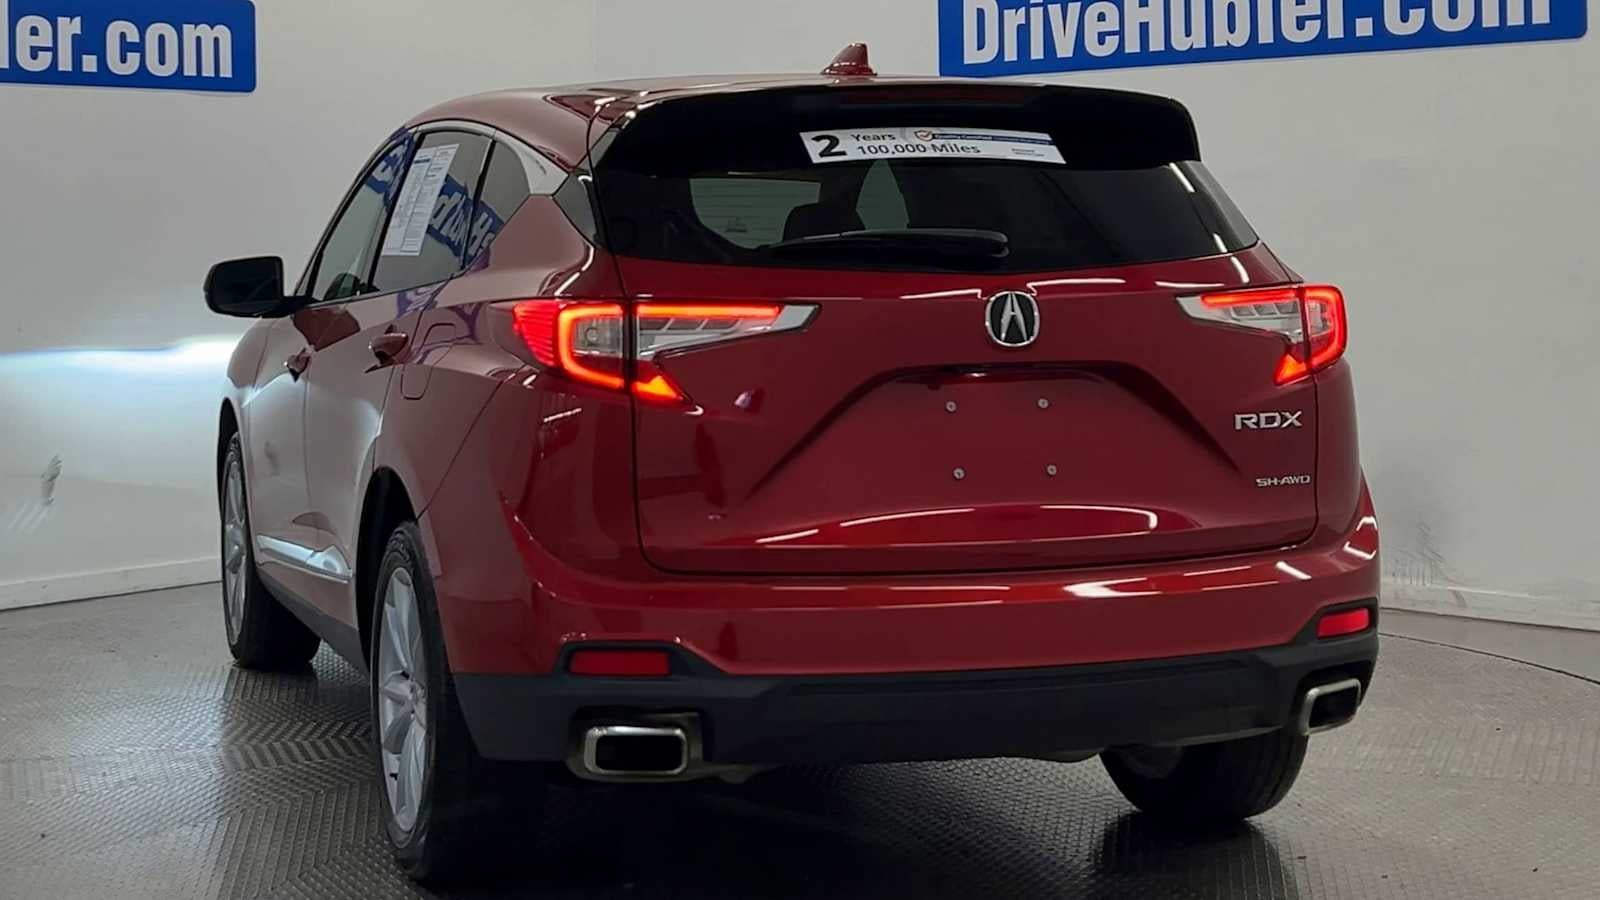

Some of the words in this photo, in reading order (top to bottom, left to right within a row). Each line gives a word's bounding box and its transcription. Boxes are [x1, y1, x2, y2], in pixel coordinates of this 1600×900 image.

[851, 132, 896, 142] Years
[811, 134, 847, 158] 2
[858, 143, 928, 155] 100,000
[931, 142, 981, 153] Miles
[1234, 411, 1302, 430] RDX
[1256, 475, 1311, 487] SH-AWD
